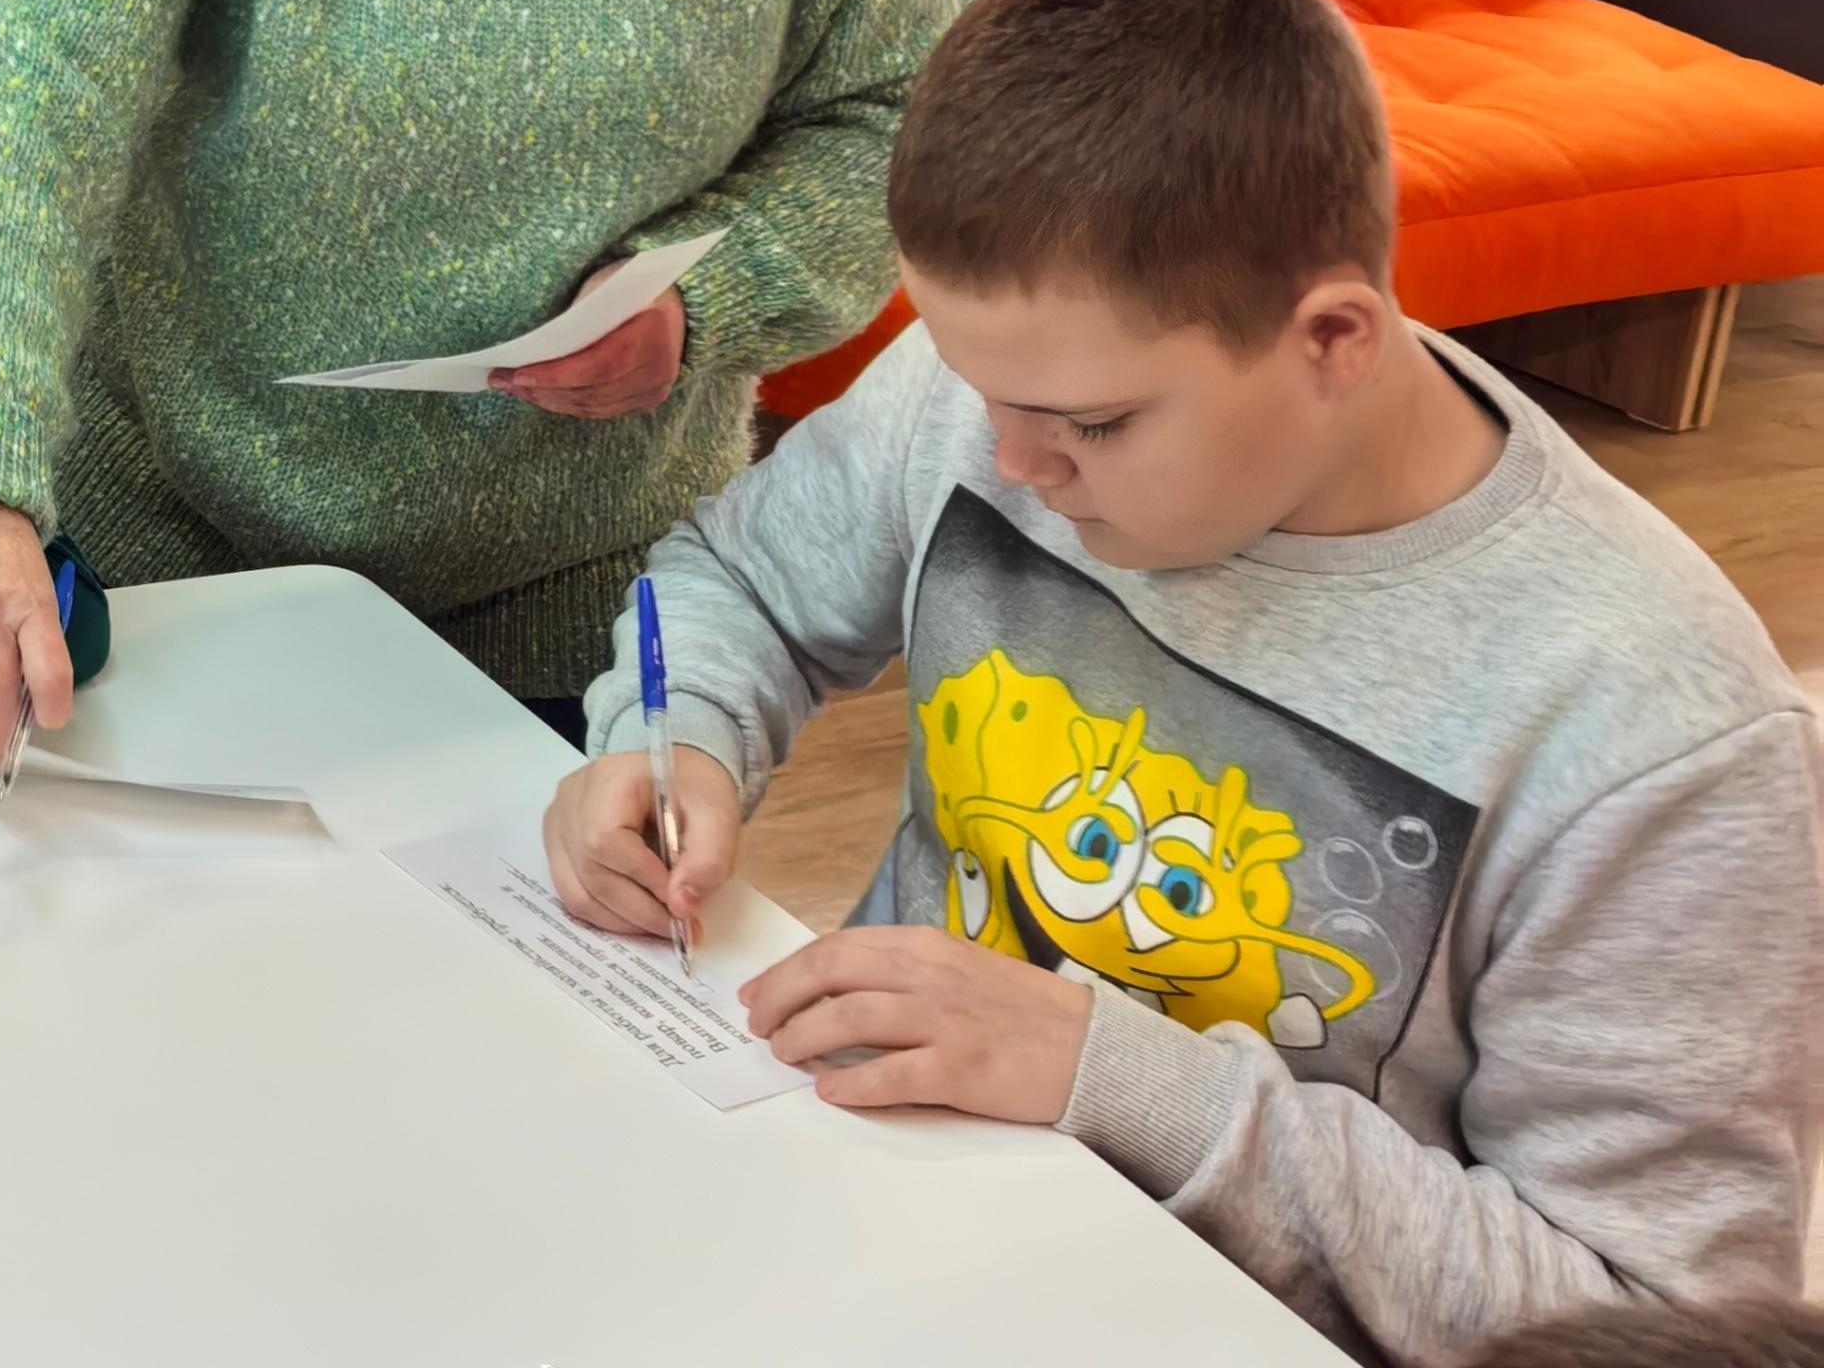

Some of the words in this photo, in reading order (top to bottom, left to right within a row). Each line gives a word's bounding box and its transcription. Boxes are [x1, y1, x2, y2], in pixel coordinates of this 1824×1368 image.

[591, 998, 653, 1041] работы
[645, 1039, 684, 1067] Для
[654, 1022, 706, 1060] повар,
